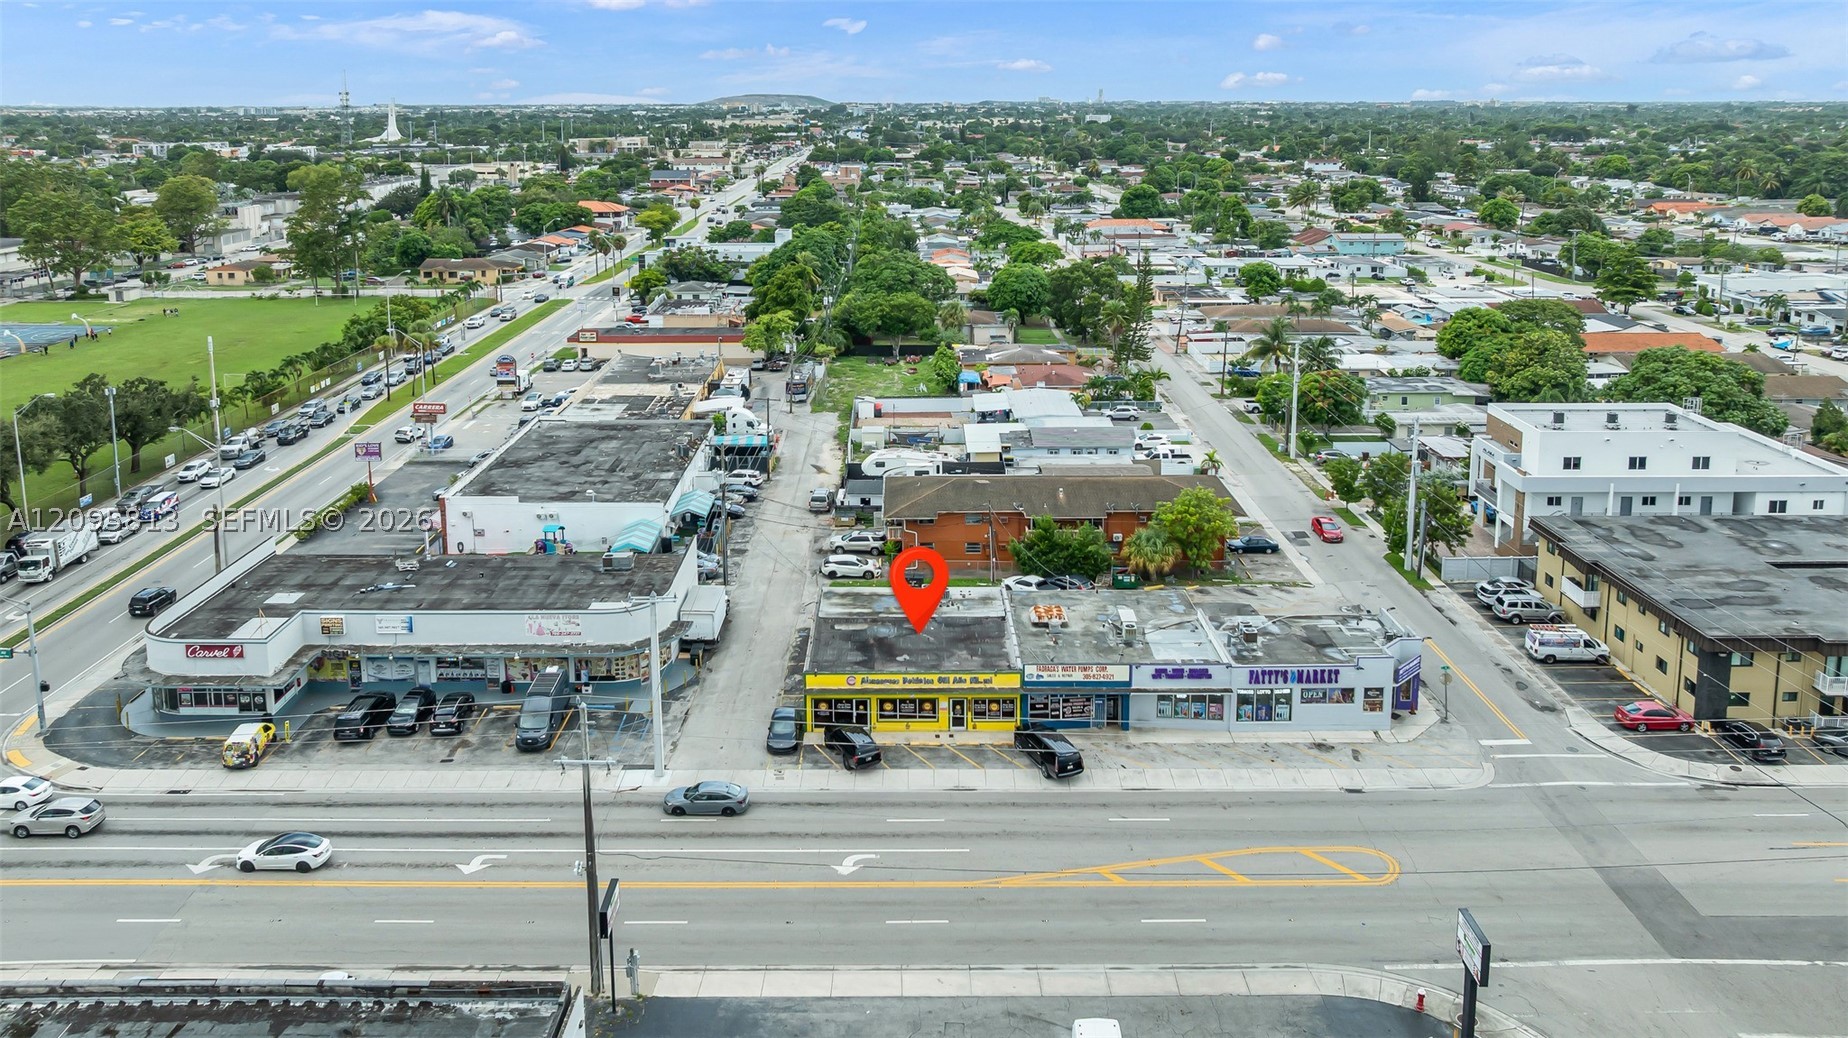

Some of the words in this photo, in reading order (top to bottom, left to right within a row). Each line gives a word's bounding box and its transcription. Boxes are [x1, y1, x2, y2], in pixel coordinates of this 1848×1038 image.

[187, 645, 230, 658] Carvel
[1061, 665, 1077, 673] WATER
[1078, 665, 1093, 673] PUMPS
[1248, 669, 1289, 685] FATTY'S
[1296, 669, 1340, 684] MARKET
[1302, 690, 1324, 699] OPEN
